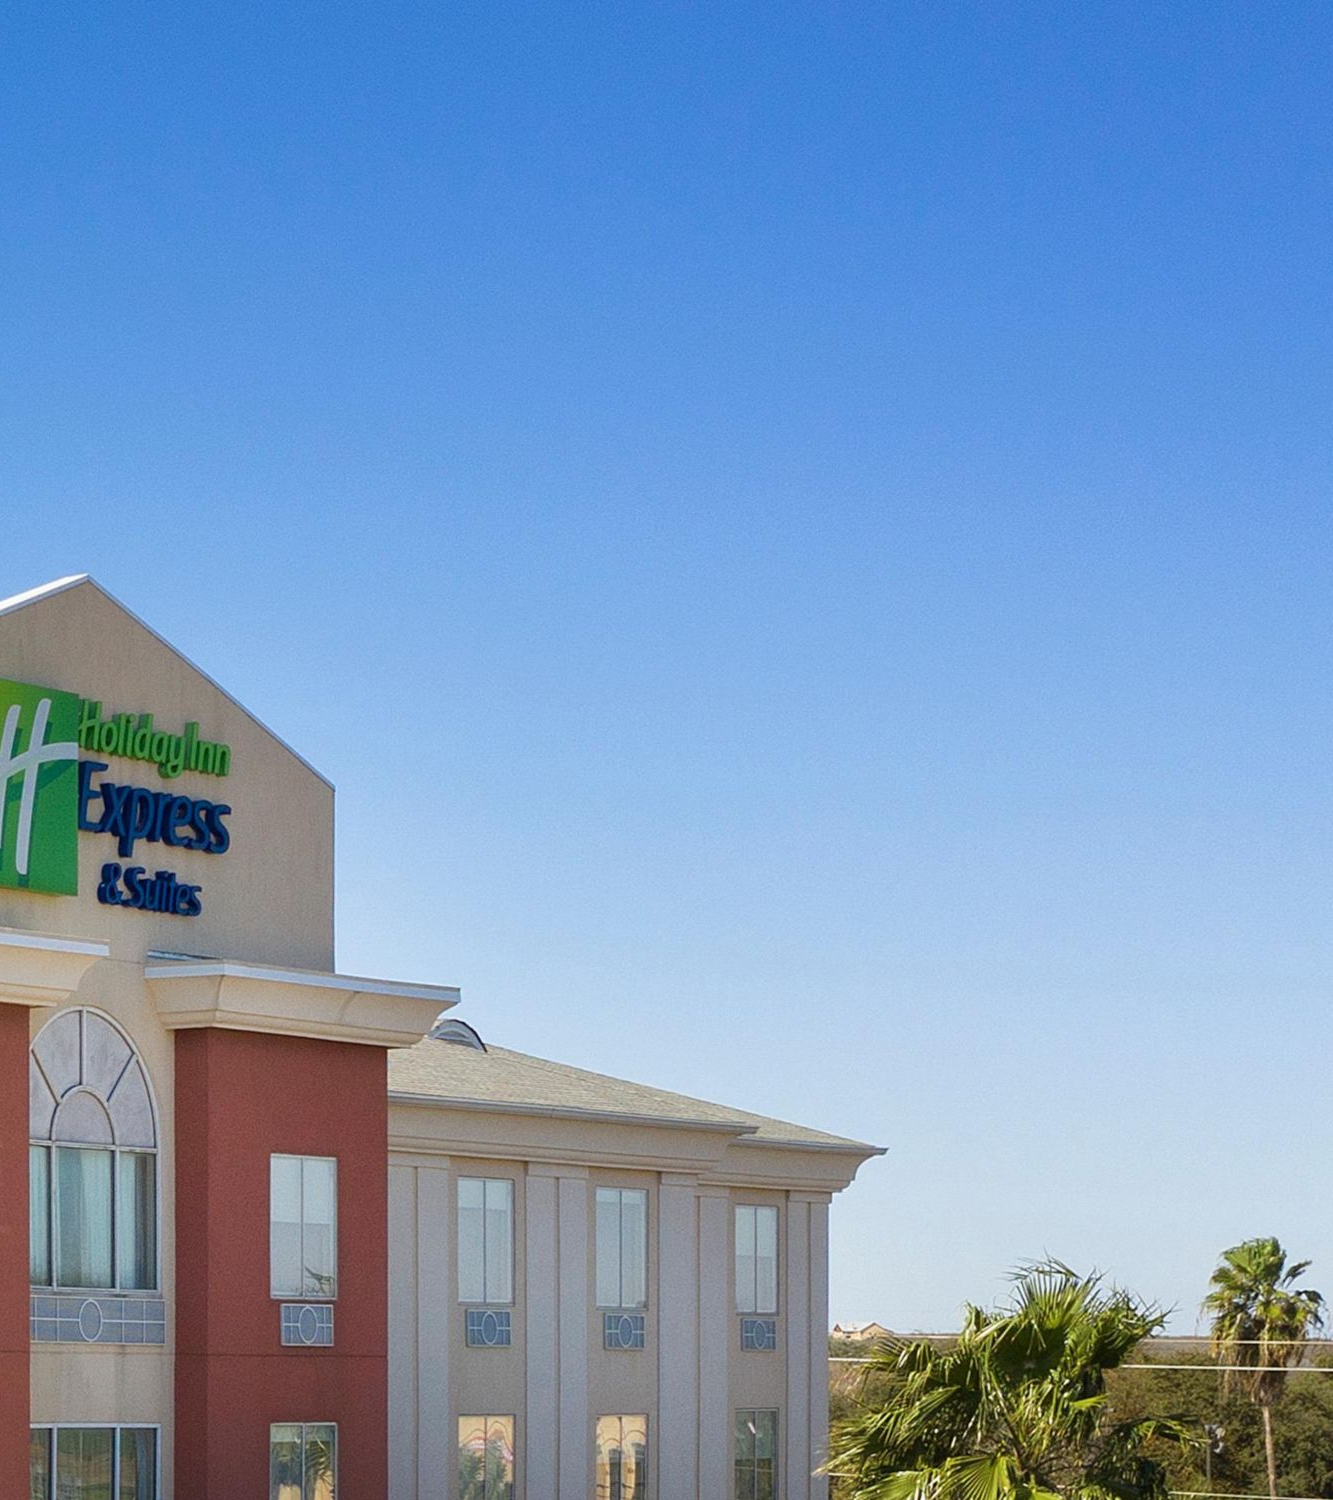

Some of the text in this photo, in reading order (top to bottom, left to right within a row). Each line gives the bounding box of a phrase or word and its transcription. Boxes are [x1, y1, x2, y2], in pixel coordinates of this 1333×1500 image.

[78, 697, 231, 779] Holiday Inn
[78, 760, 232, 858] Express
[97, 862, 203, 917] & Suites
